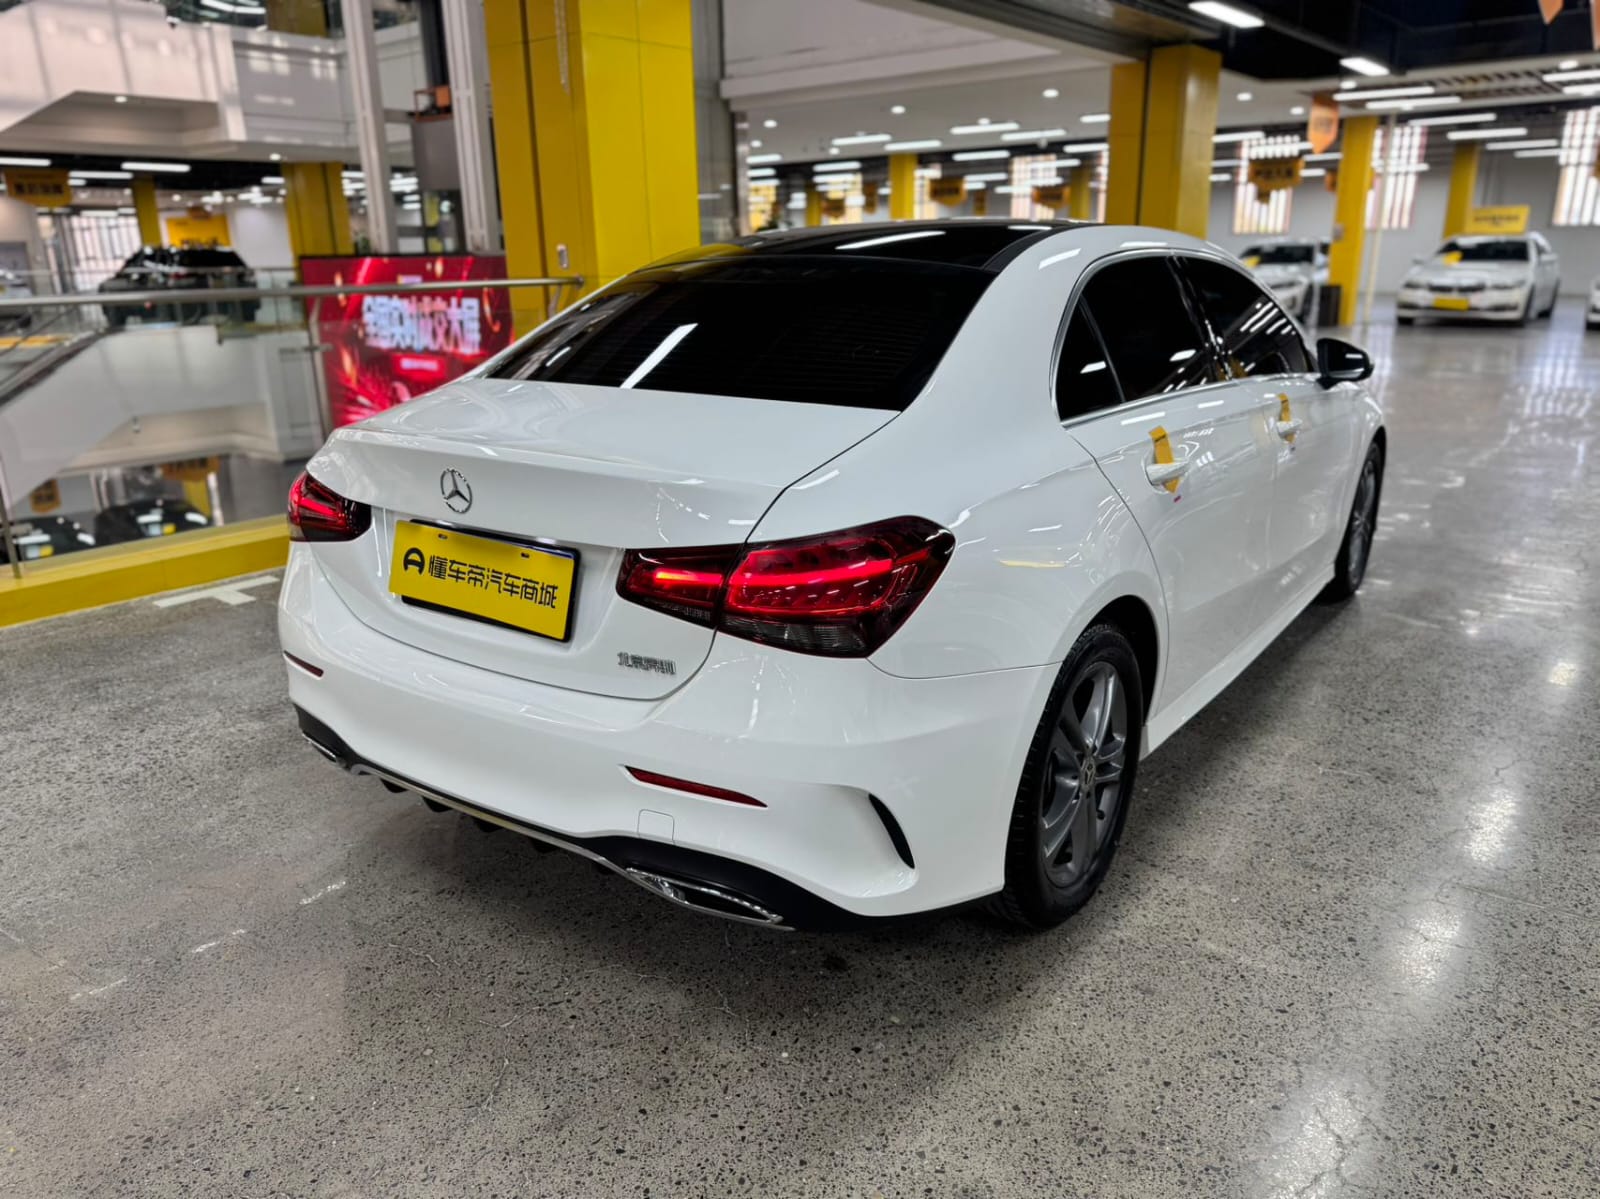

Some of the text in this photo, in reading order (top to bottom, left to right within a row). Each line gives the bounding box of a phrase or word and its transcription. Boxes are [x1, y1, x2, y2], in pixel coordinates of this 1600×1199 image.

[429, 555, 559, 609] 懂车帝汽车商城
